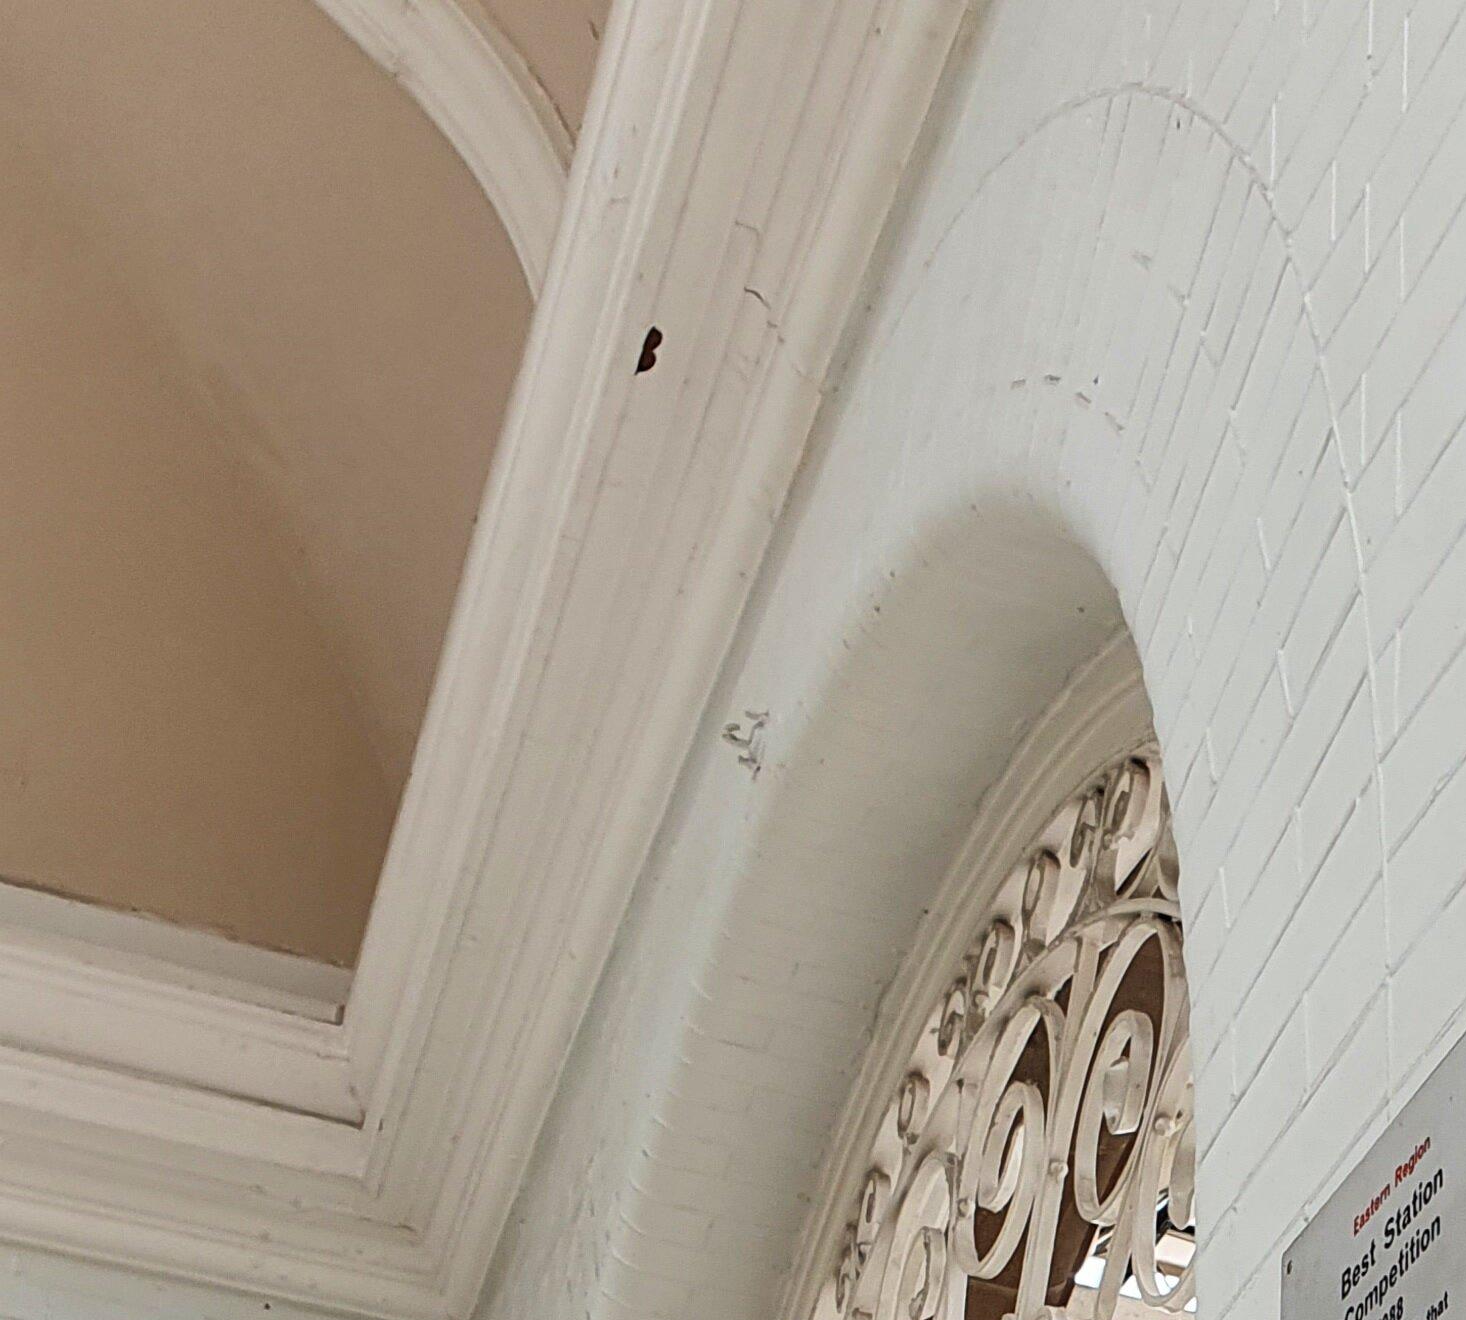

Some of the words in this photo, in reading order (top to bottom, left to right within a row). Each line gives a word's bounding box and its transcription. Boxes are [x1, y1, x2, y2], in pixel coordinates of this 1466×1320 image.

[1341, 1238, 1376, 1300] Best
[1384, 1168, 1444, 1249] Station
[1353, 1183, 1391, 1237] Eastern
[1394, 1136, 1431, 1187] Region
